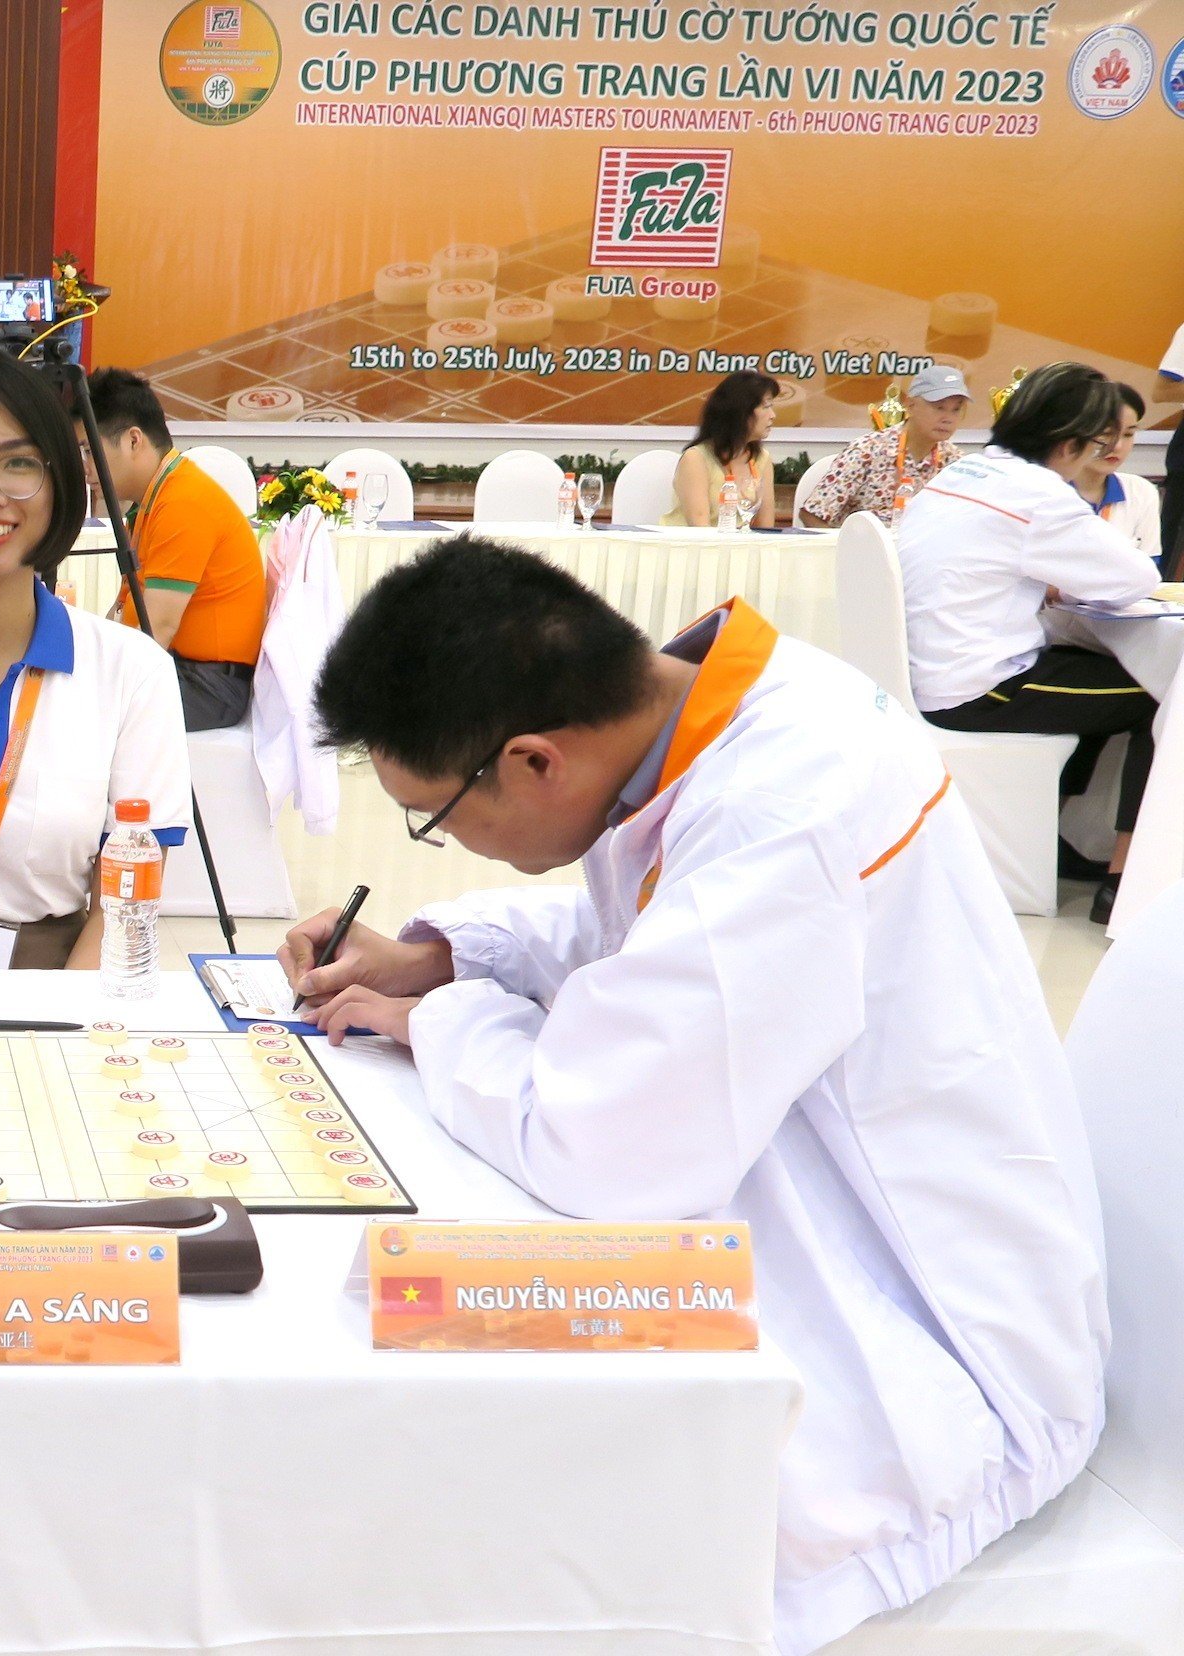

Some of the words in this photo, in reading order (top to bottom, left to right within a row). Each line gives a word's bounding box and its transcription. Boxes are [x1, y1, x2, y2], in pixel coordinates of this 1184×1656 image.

[475, 5, 580, 38] DANH
[679, 1, 735, 41] CỜ
[742, 2, 878, 43] TƯỚNG
[889, 1, 998, 48] QUỐC
[1009, 2, 1056, 46] TẾ
[301, 51, 376, 91] CÚP
[389, 60, 564, 95] PHƯƠNG
[576, 64, 707, 98] TRANG
[719, 53, 792, 98] LẦN
[805, 68, 840, 99] VI
[852, 60, 944, 101] NĂM
[955, 70, 1044, 103] 2023
[297, 103, 442, 126] INTERNATIONAL
[448, 106, 526, 129] XIANGQI
[533, 107, 616, 129] MASTERS
[622, 108, 752, 131] TOURNAMENT
[768, 112, 797, 131] 6th
[803, 112, 882, 133] PHUONG
[889, 113, 948, 134] TRANG
[954, 114, 991, 135] CUP
[995, 115, 1039, 135] 2023
[586, 276, 635, 296] FUTA
[640, 276, 717, 301] Group
[350, 345, 404, 369] 15th
[412, 348, 437, 369] to
[443, 346, 498, 370] 25th
[503, 347, 557, 375] July,
[563, 348, 622, 371] 2023
[628, 348, 652, 371] in
[658, 350, 690, 372] Da
[765, 350, 816, 379] City,
[823, 351, 871, 374] Viet
[877, 352, 934, 375] Nam
[4, 1298, 33, 1323] A
[42, 1292, 150, 1323] SÁNG
[456, 1276, 566, 1311] NGUYỄN
[574, 1280, 670, 1311] HOÀNG
[677, 1280, 735, 1311] LÂM
